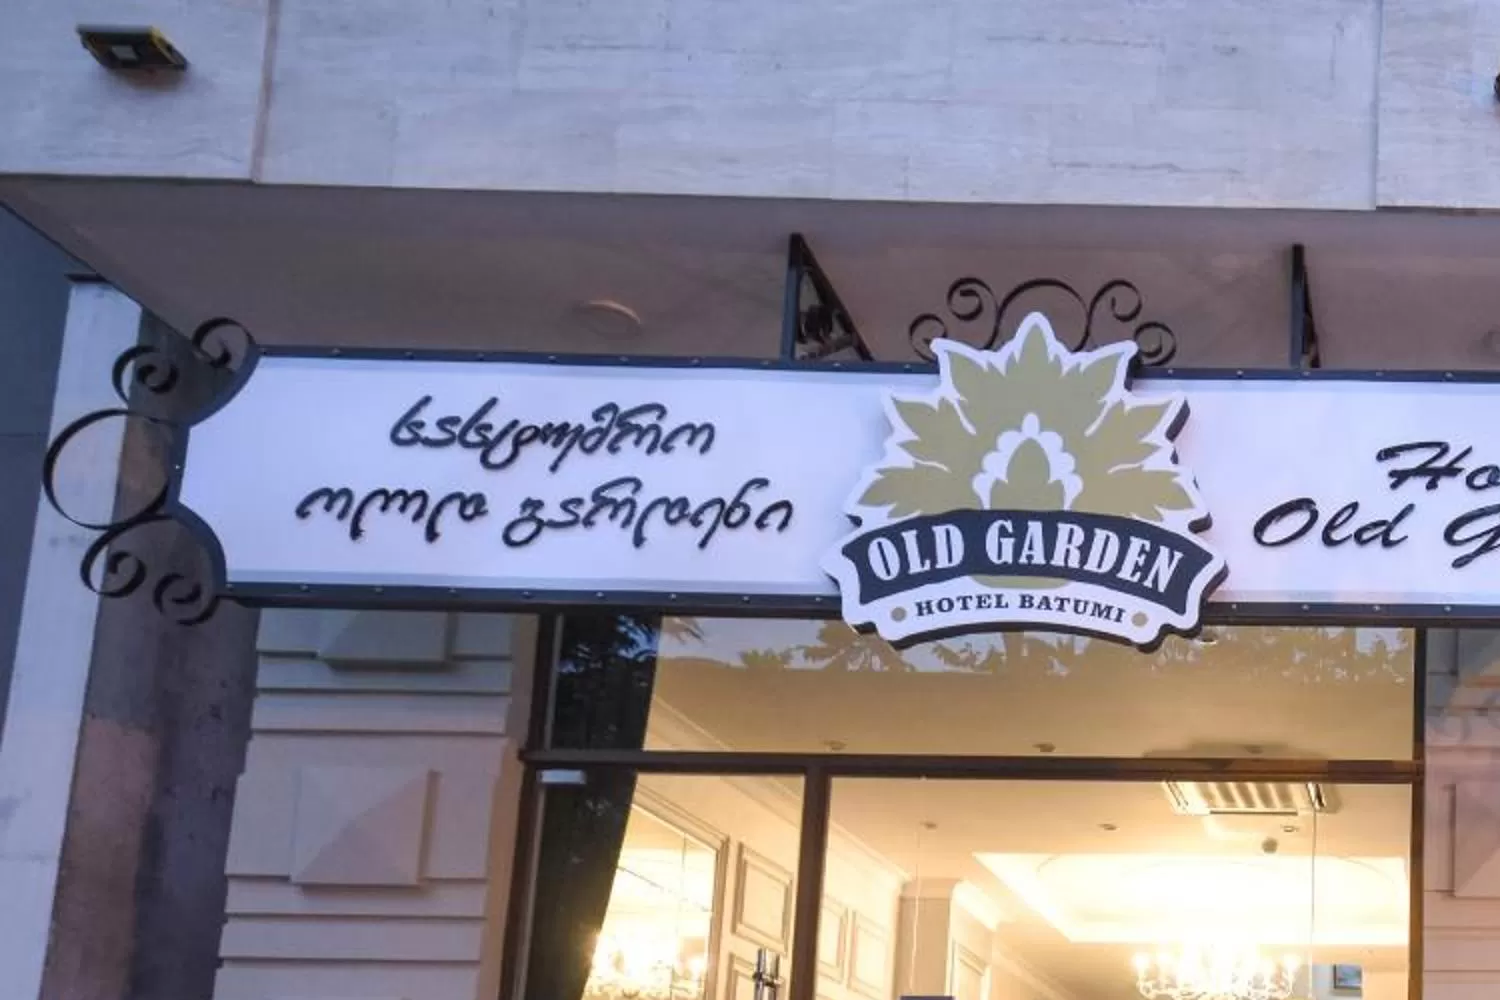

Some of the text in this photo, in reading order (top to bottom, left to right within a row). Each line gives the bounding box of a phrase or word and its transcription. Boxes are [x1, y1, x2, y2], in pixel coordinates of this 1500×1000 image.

[1253, 497, 1413, 549] Old
[867, 519, 1184, 594] OLD GARDEN
[914, 593, 1127, 624] HOTEL BATUMI
